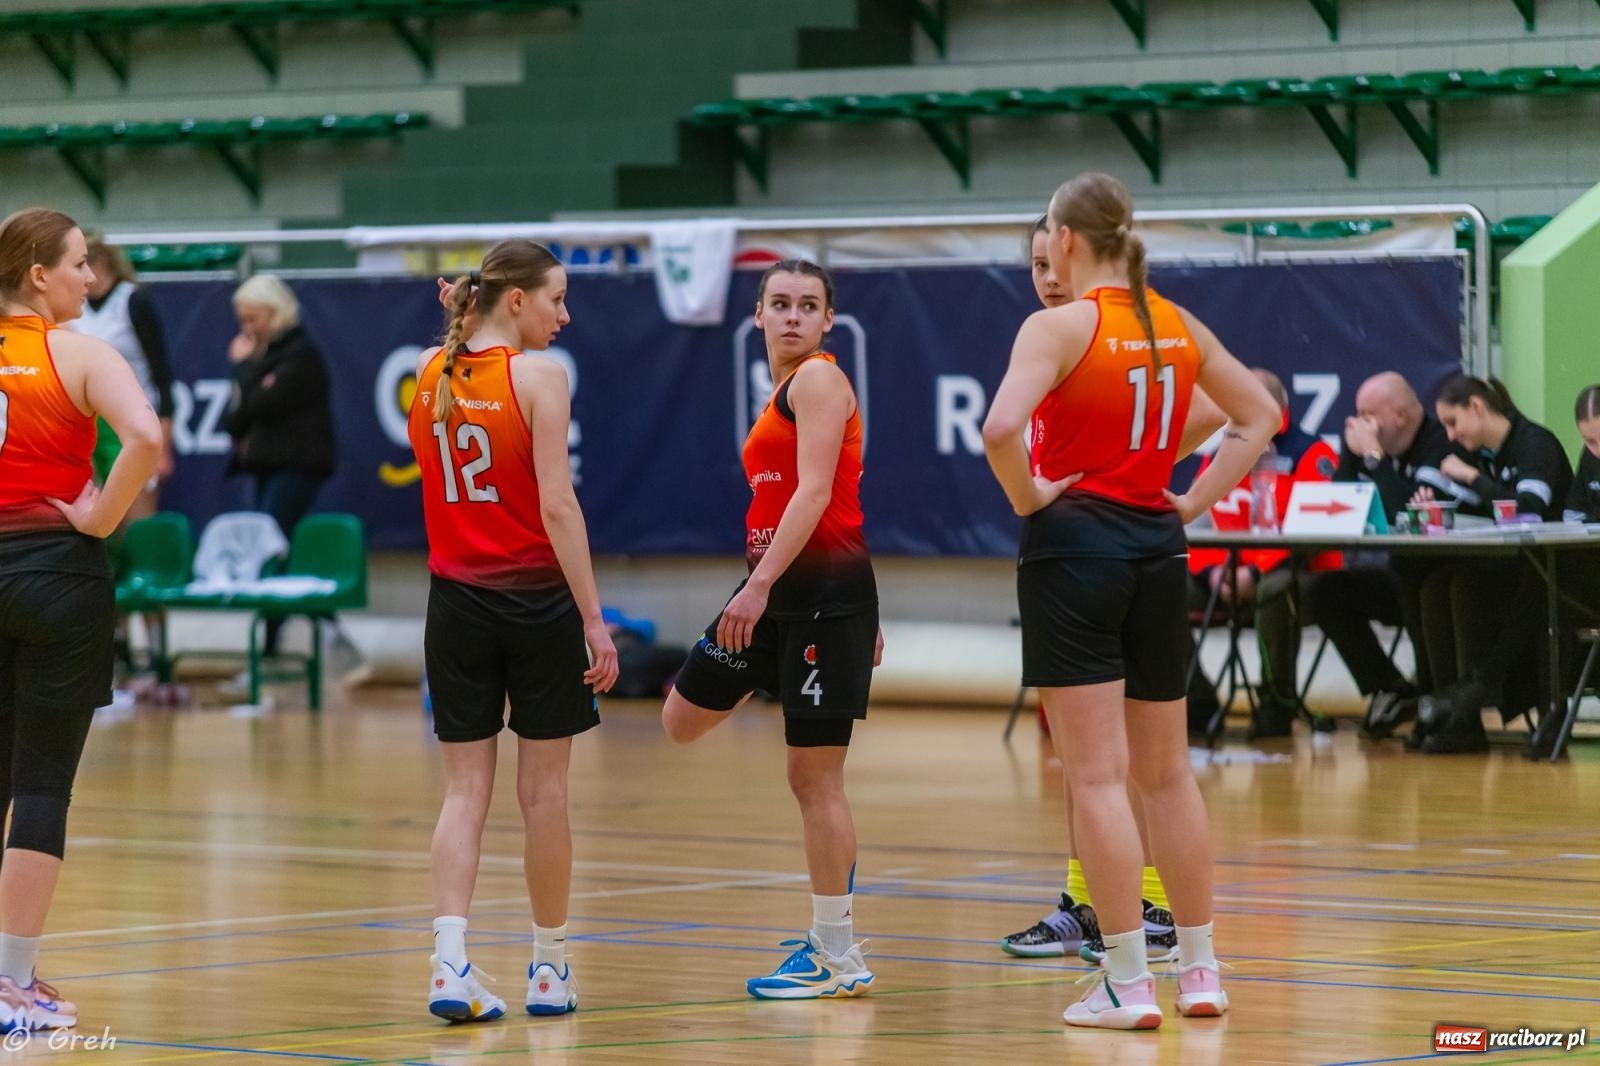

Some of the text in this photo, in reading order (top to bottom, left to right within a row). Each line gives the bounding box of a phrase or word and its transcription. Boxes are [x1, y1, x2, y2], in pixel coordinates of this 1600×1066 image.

[1127, 364, 1176, 451] 11
[432, 421, 501, 503] 12
[704, 642, 748, 671] GROUP
[801, 668, 823, 706] 4
